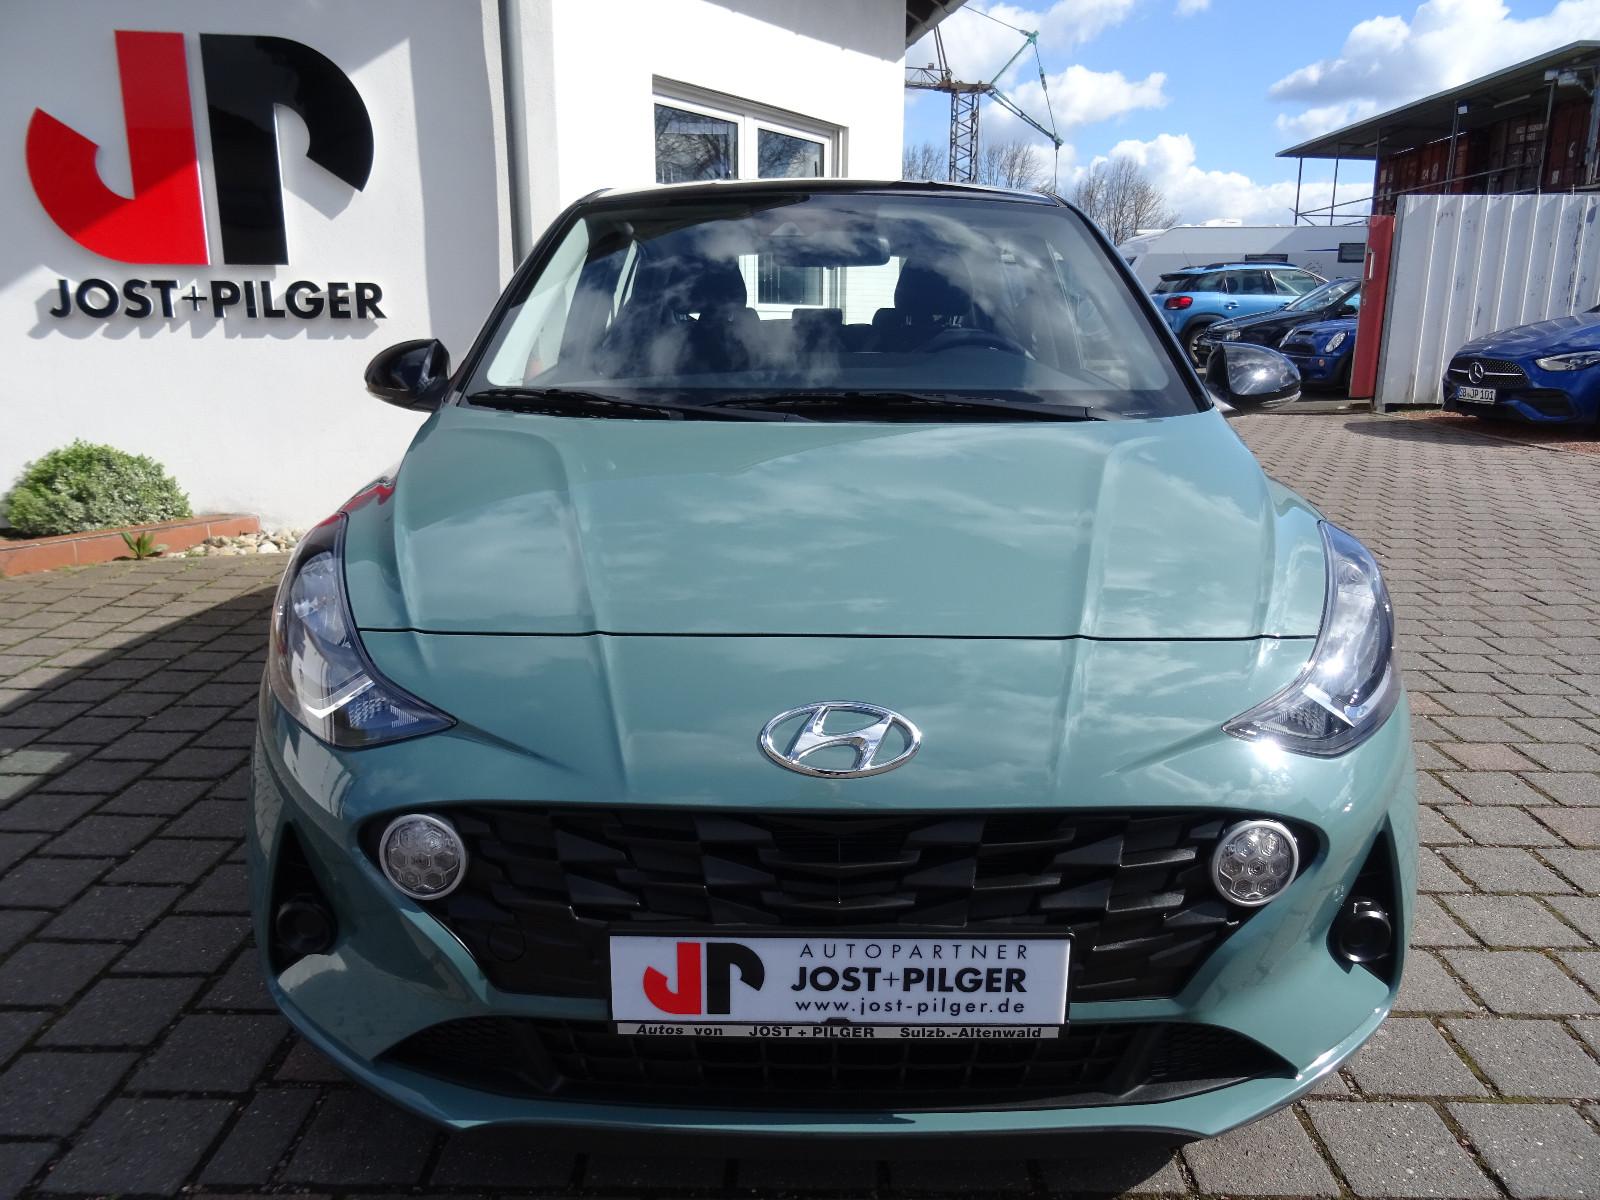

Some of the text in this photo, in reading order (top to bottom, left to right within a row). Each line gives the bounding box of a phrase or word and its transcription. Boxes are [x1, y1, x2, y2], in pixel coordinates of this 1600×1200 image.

[49, 278, 387, 320] JOST+PILGER
[1480, 390, 1494, 400] 101
[800, 943, 1028, 960] AUTOPARTNER
[791, 966, 1028, 993] JOST+PILGER
[795, 997, 1026, 1016] www.jost-pilger.de
[636, 1024, 684, 1036] Autos
[694, 1027, 723, 1036] von
[749, 1026, 793, 1037] JOST
[813, 1027, 875, 1038] PILGER
[900, 1027, 1042, 1038] Sulzb.-Altenwald
